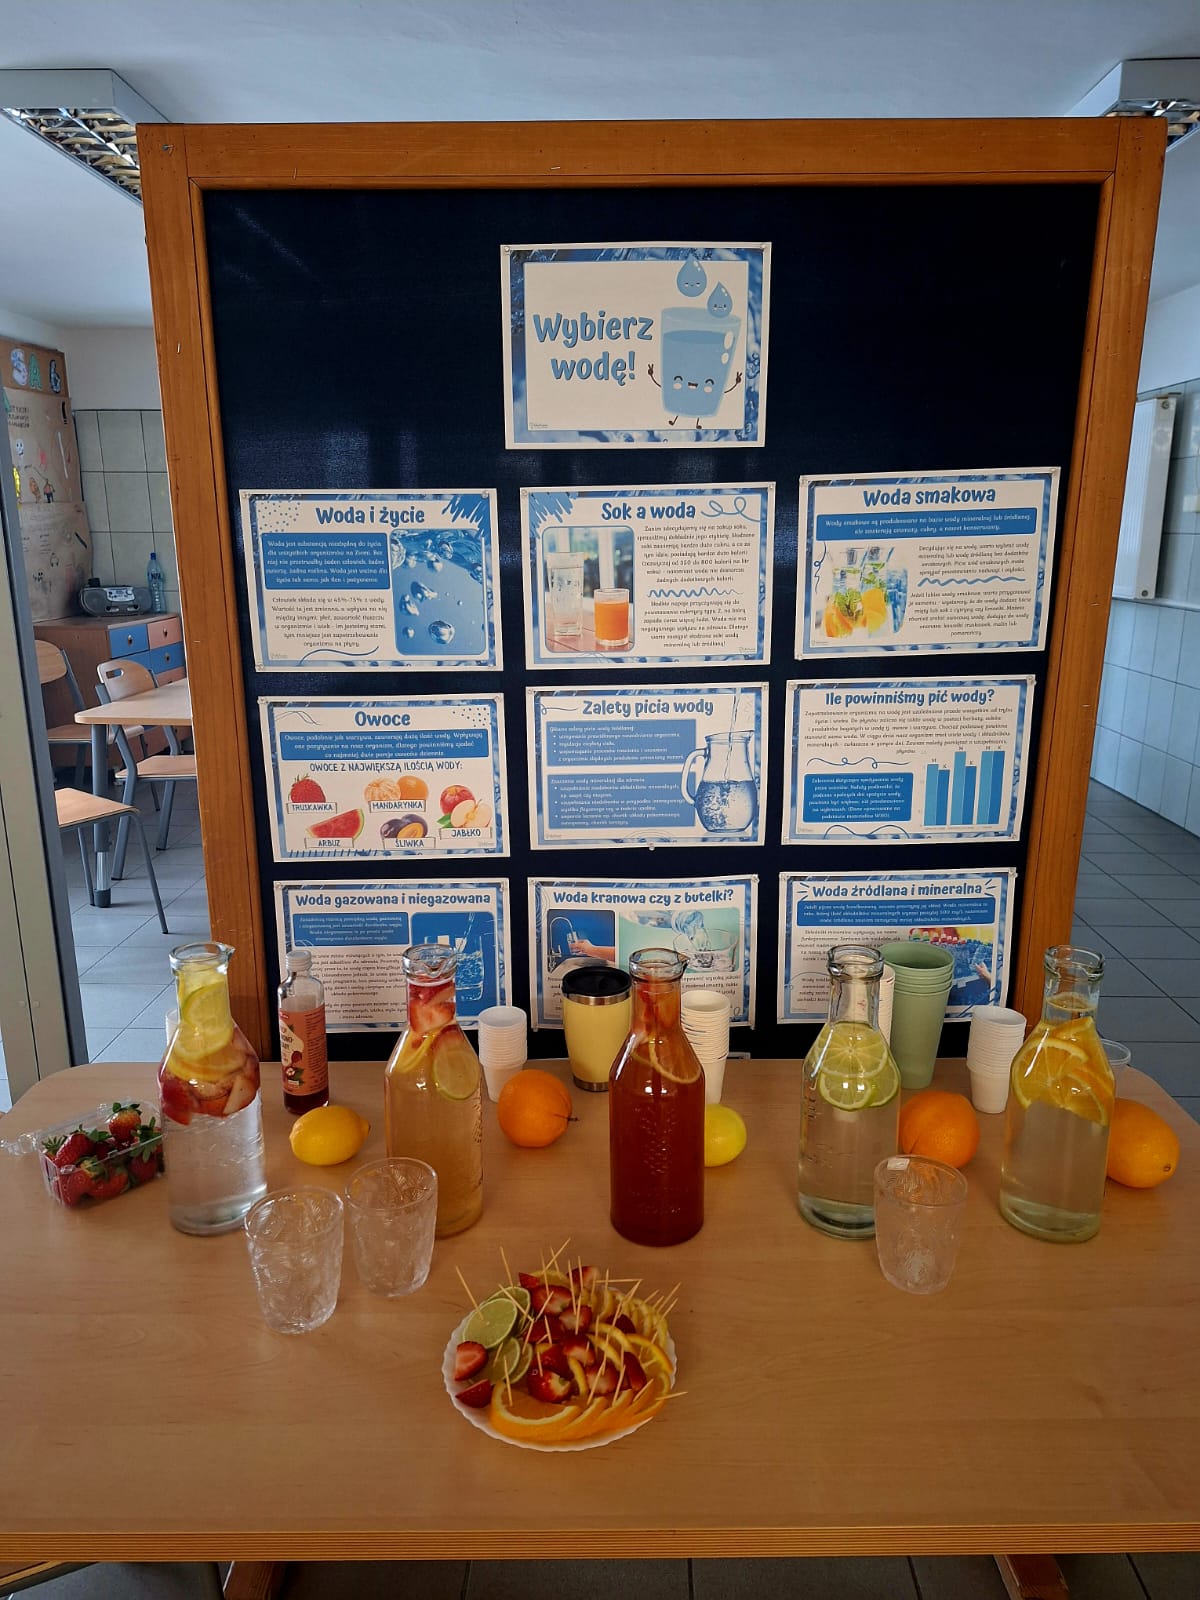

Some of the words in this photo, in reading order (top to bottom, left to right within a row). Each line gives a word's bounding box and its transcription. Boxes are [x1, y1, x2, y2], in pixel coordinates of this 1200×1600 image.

[533, 311, 653, 348] Wybierz
[551, 351, 635, 386] wodę!
[864, 489, 911, 507] Woda
[916, 486, 995, 504] smakowa
[316, 507, 365, 524] Woda
[370, 506, 374, 523] i
[379, 506, 424, 528] życie
[602, 503, 631, 520] Sok
[637, 507, 646, 519] a
[650, 502, 695, 519] woda
[826, 693, 841, 705] Ile
[845, 691, 924, 707] powinniśmy
[929, 690, 947, 706] pić
[951, 689, 994, 705] wody?
[583, 700, 631, 717] Zalety
[635, 699, 669, 717] picia
[674, 699, 713, 716] wody
[355, 711, 410, 726] Owoce
[310, 763, 338, 771] OWOCE
[341, 763, 346, 771] Z
[348, 763, 401, 773] NAJWIĘKSZĄ
[404, 760, 434, 771] ILOŚCIĄ
[436, 761, 462, 769] WODY:
[292, 802, 333, 811] TRUSKAWKA
[372, 800, 422, 809] MANDARYNKA
[452, 829, 481, 837] JABŁKO
[317, 840, 340, 848] ARBUZ
[394, 837, 426, 847] ŚLIWKA
[554, 892, 588, 903] Woda
[591, 892, 646, 903] kranowa
[649, 895, 671, 906] czy
[674, 895, 681, 903] z
[683, 887, 733, 903] butelki?
[813, 886, 848, 897] Woda
[851, 885, 907, 896] źródlana
[911, 884, 915, 895] i
[918, 883, 982, 895] mineralna
[296, 894, 331, 906] Woda
[335, 896, 398, 908] gazowana
[402, 893, 405, 904] i
[409, 893, 490, 907] niegazowana
